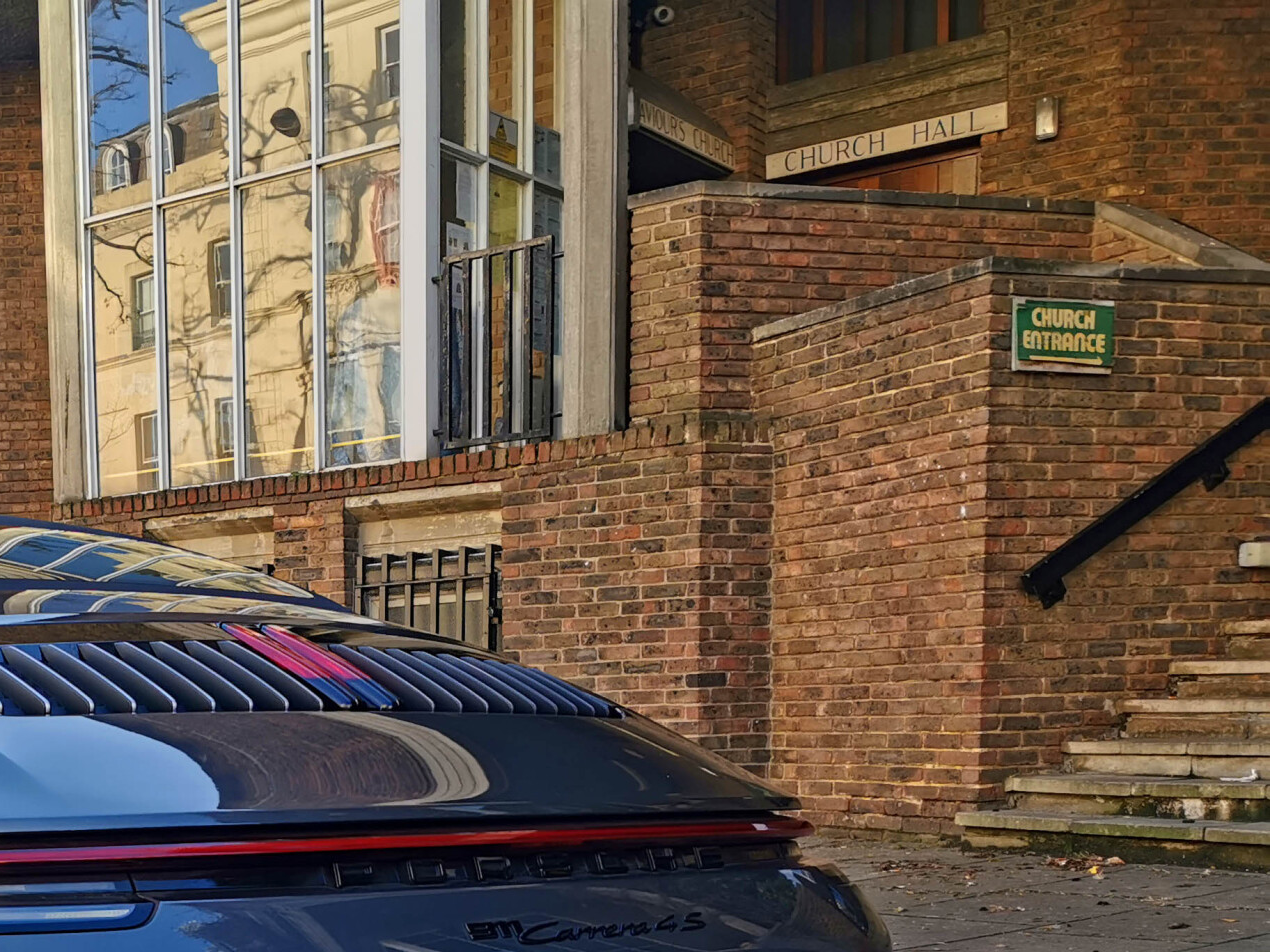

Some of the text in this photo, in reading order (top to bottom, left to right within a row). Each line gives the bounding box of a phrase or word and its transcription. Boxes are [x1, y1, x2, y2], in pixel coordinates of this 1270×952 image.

[692, 128, 734, 167] CHURCH
[784, 111, 986, 172] CHURCH HALL
[1031, 307, 1096, 330] CHURCH
[1022, 330, 1106, 353] ENTRANCE
[332, 846, 725, 889] PORSCHE
[465, 919, 524, 941] 911
[518, 918, 649, 945] Carrera
